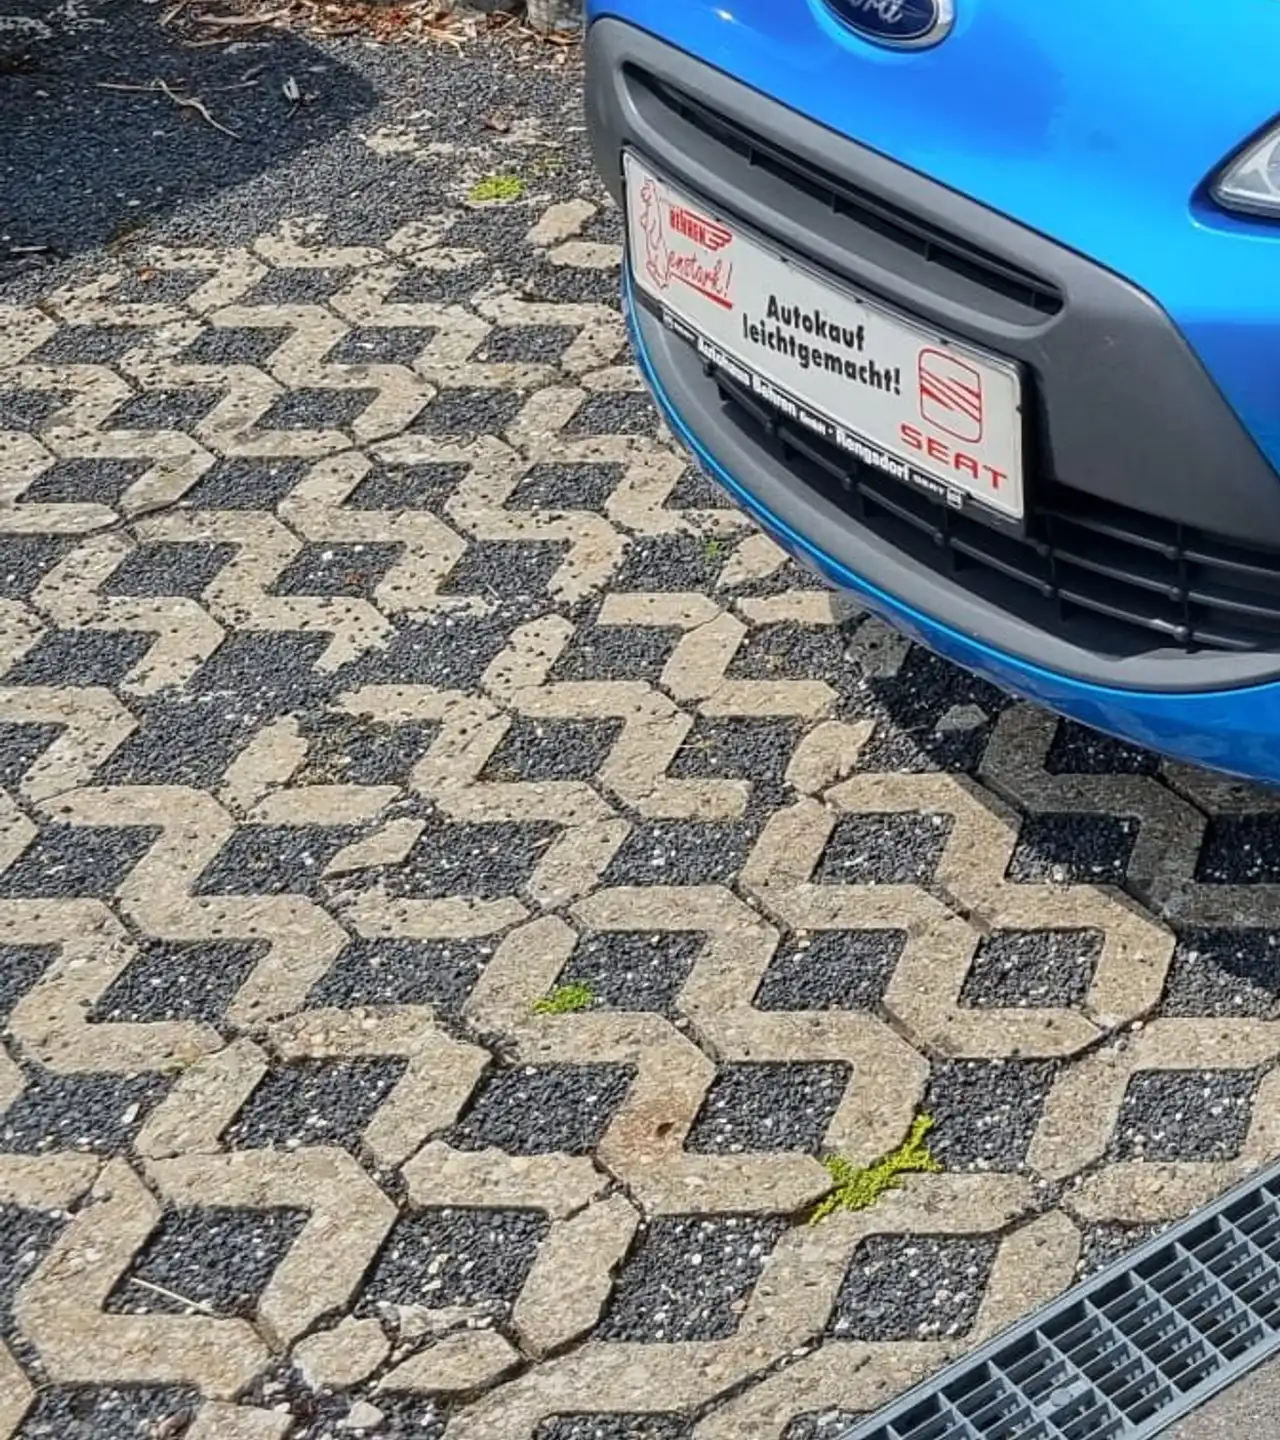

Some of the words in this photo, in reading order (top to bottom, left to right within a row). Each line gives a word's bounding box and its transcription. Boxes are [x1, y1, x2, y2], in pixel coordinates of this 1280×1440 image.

[742, 312, 901, 396] leichtgemacht!
[766, 294, 865, 352] Autokauf
[900, 423, 1008, 490] SEAT
